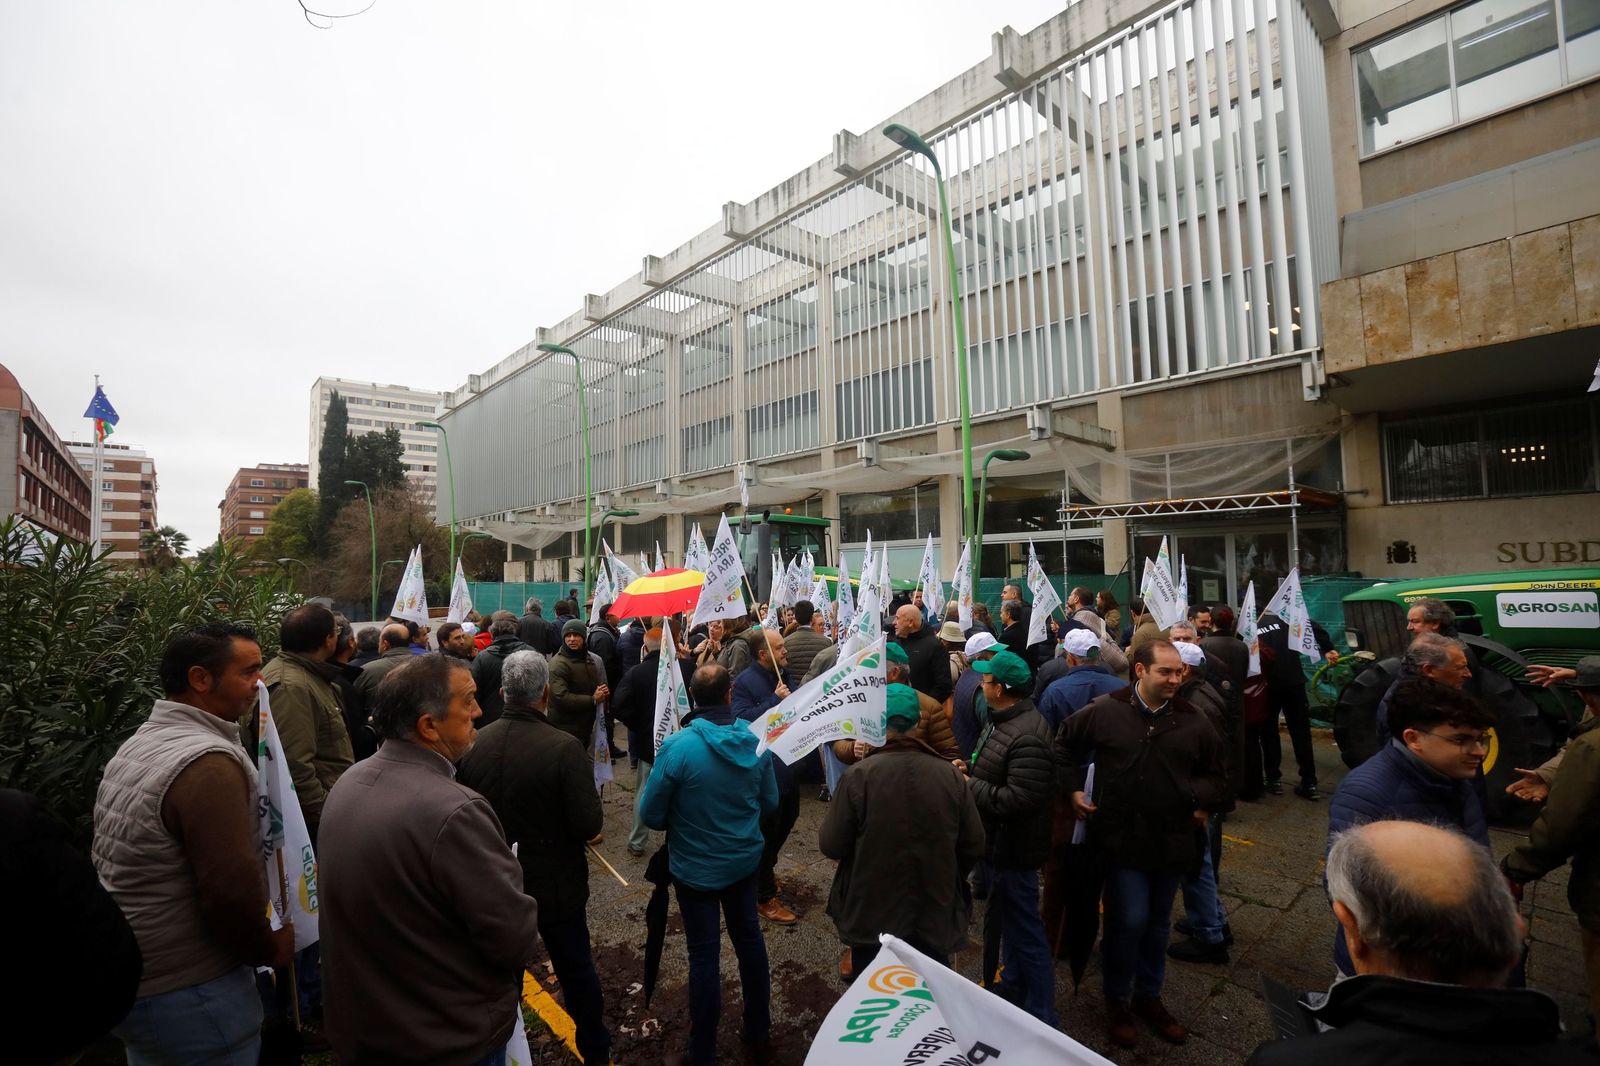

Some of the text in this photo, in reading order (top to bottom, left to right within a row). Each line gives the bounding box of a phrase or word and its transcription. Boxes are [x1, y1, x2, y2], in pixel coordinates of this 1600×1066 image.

[1528, 582, 1597, 591] JOHN DEERE
[1506, 602, 1598, 615] AGROSAN
